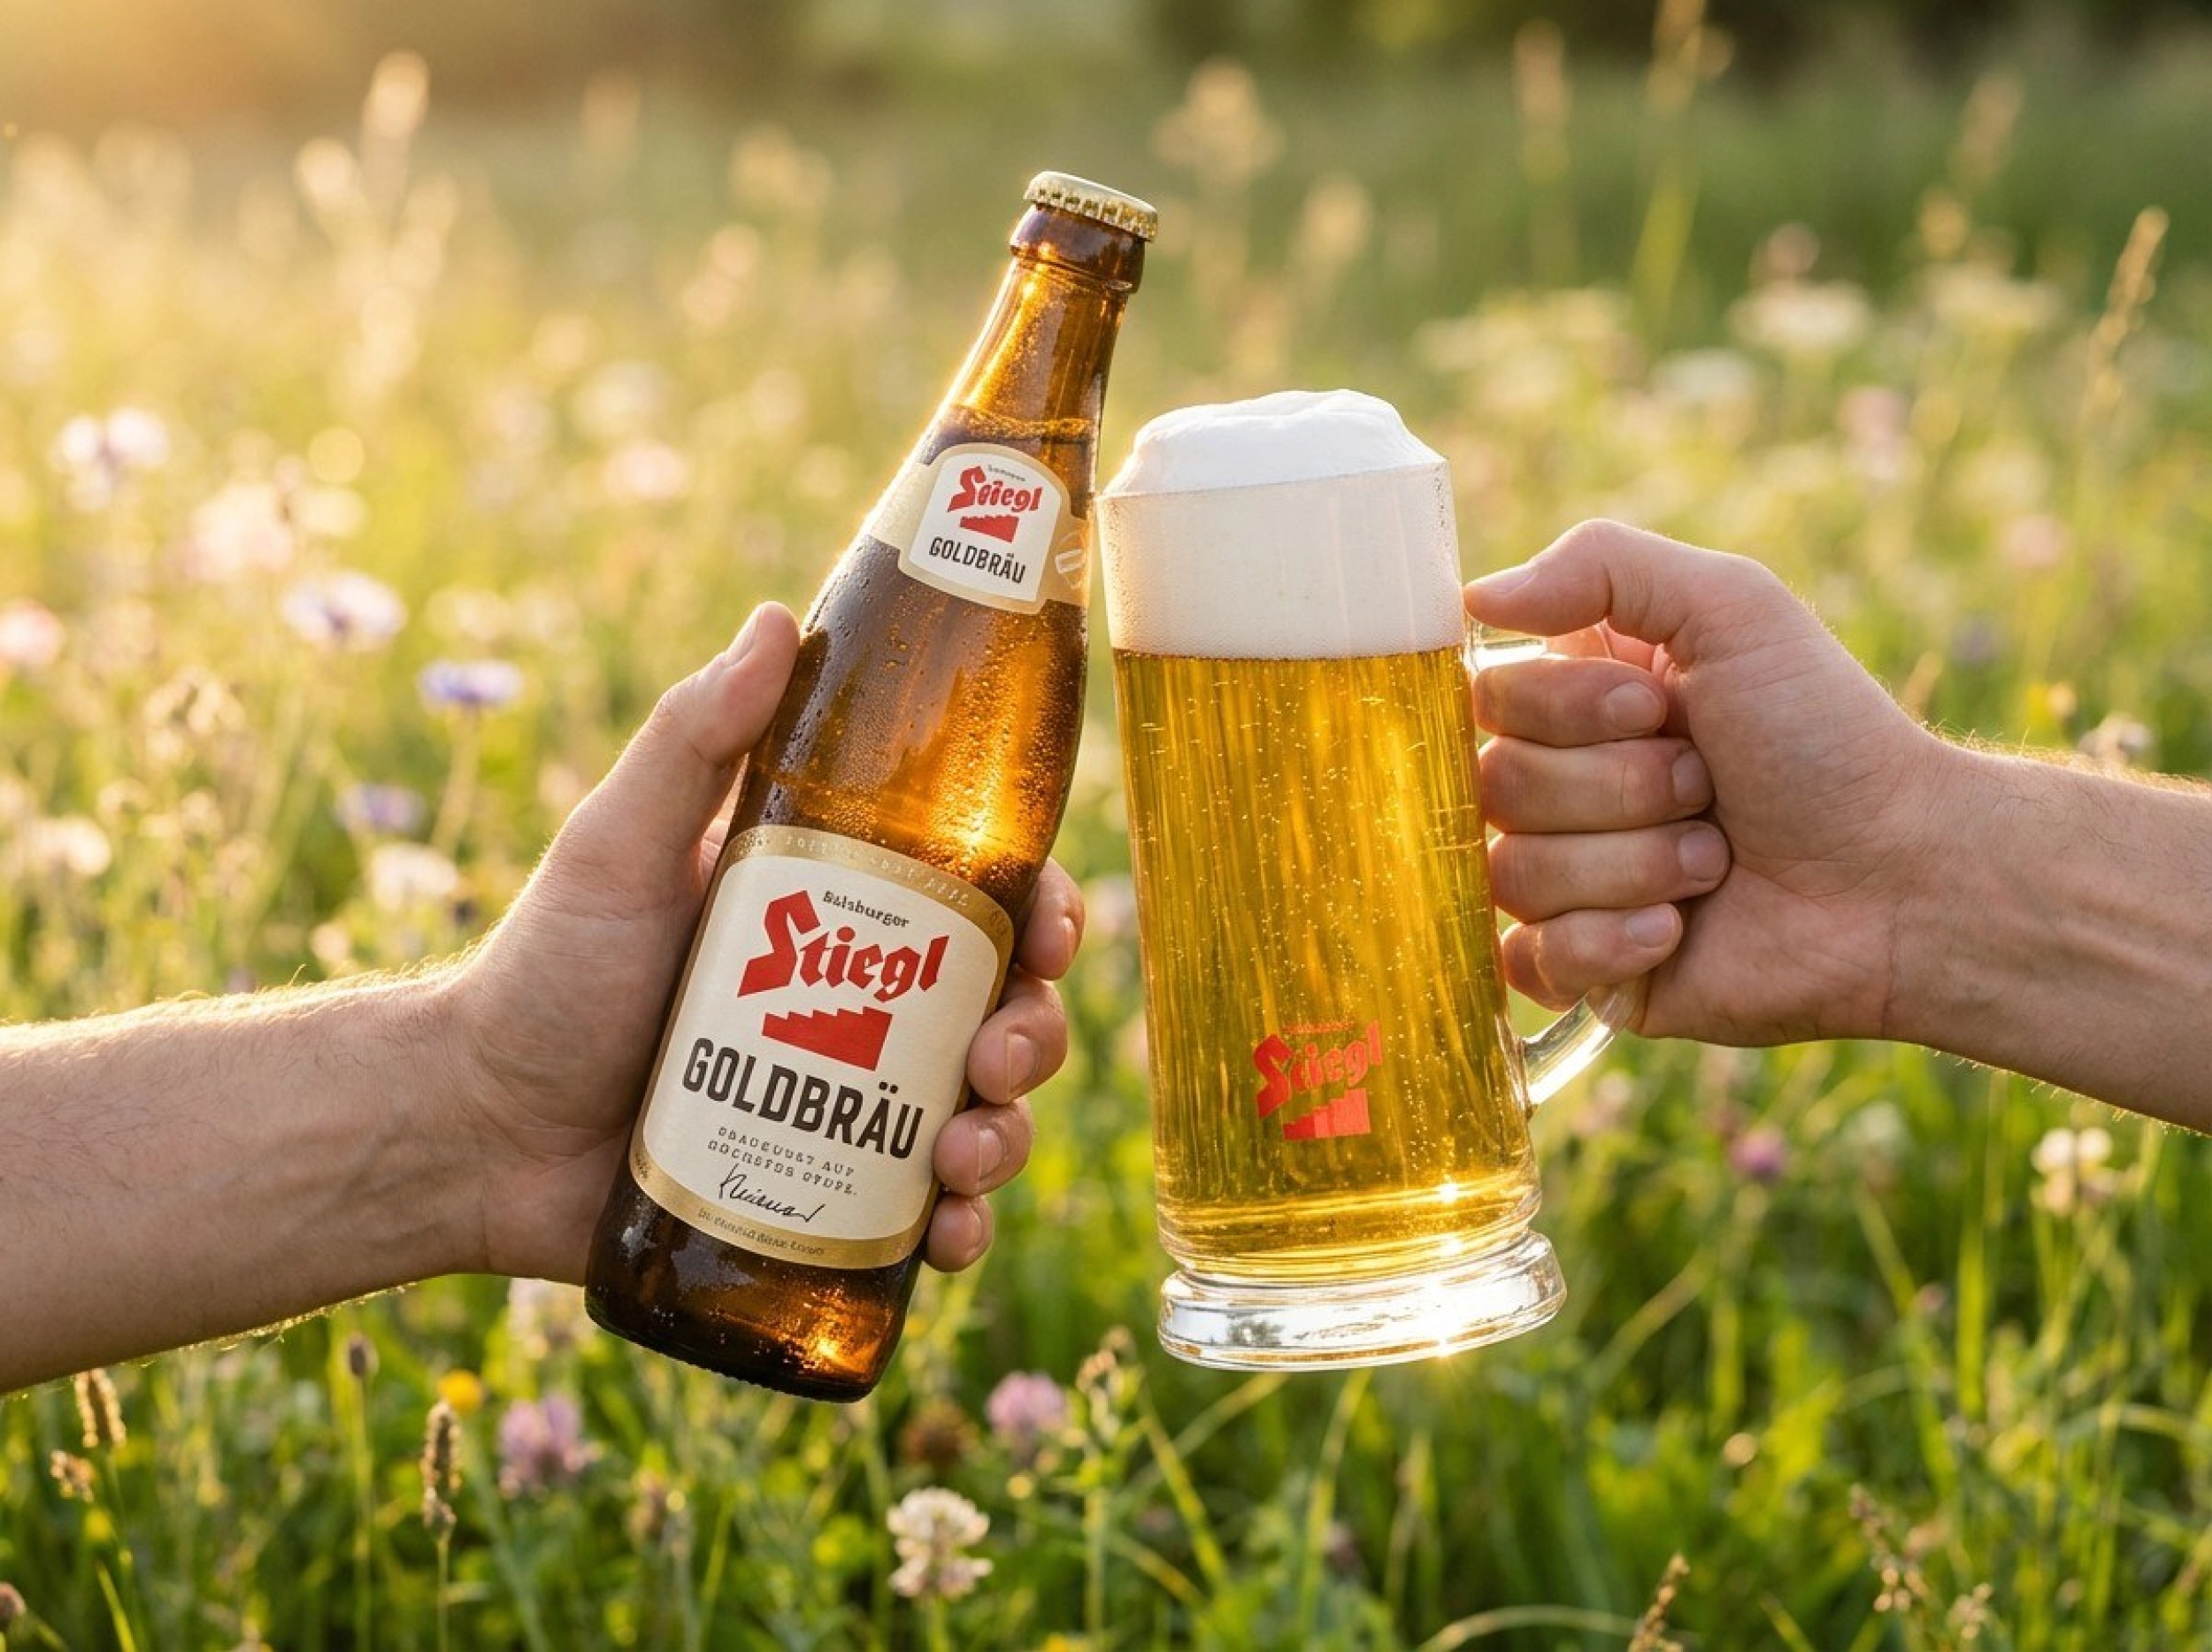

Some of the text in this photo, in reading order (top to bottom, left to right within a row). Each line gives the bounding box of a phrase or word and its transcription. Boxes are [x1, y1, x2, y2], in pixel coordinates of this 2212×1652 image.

[929, 536, 1025, 584] GOLDBRÄU
[738, 889, 949, 1003] Stiegl
[682, 1037, 924, 1159] GOLDBRÄU
